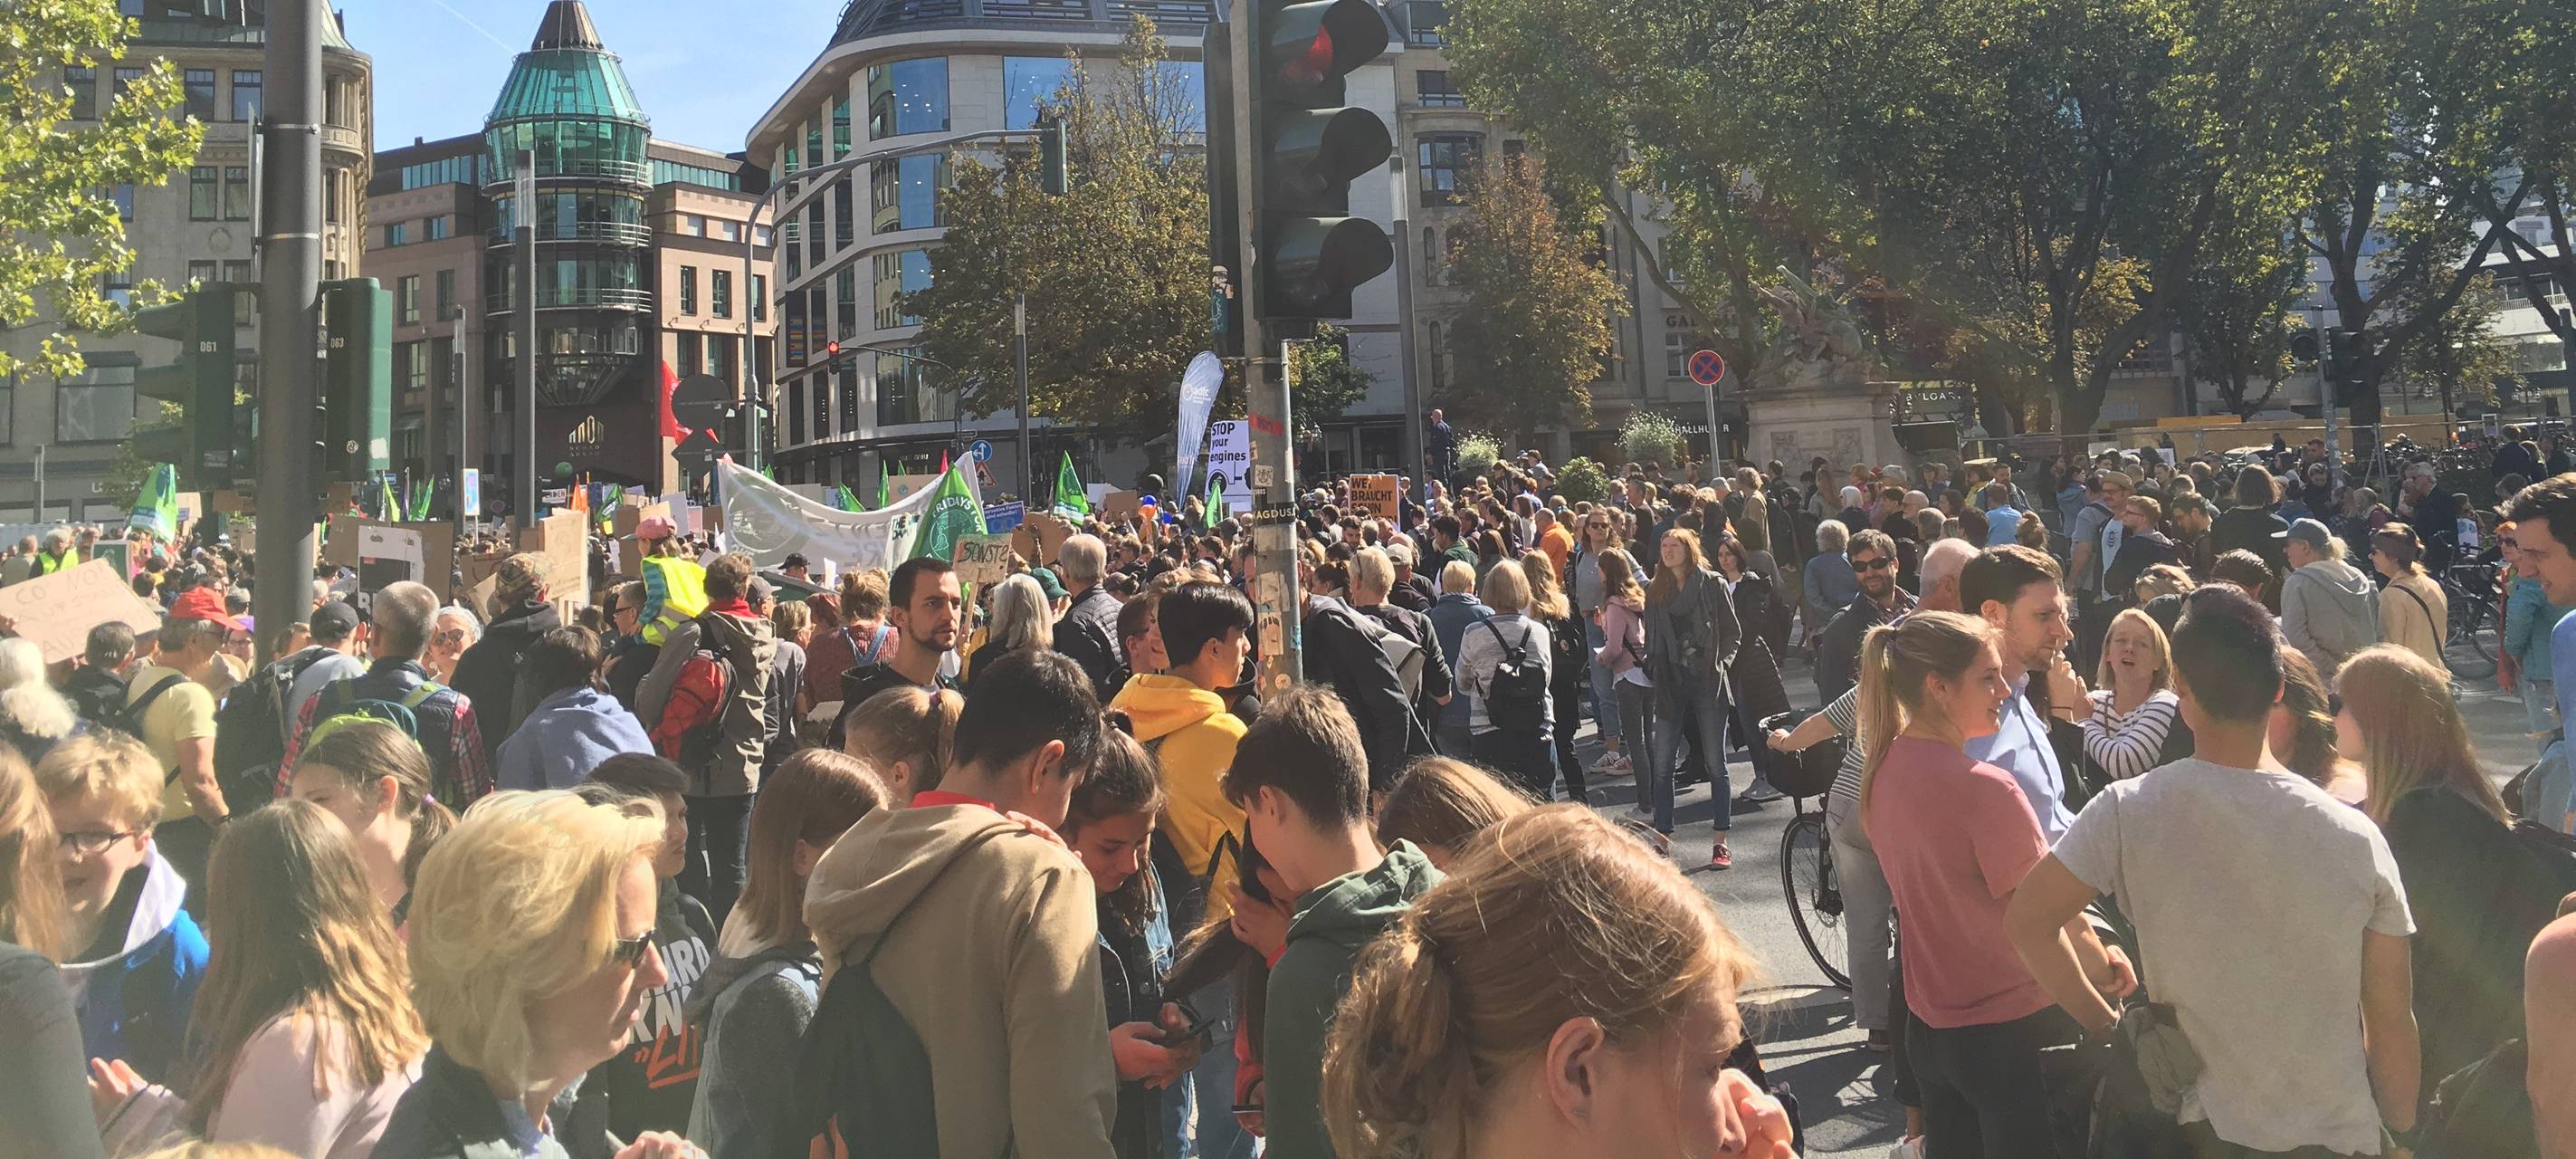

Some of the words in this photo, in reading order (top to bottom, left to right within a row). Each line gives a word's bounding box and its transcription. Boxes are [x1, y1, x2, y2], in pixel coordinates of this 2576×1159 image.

[1905, 391, 1961, 402] BLGAR
[1211, 422, 1236, 436] STOP
[1674, 423, 1730, 435] HALLHUR
[1211, 436, 1229, 451] your
[1209, 451, 1246, 464] engines
[1350, 490, 1393, 502] BRAUCHT
